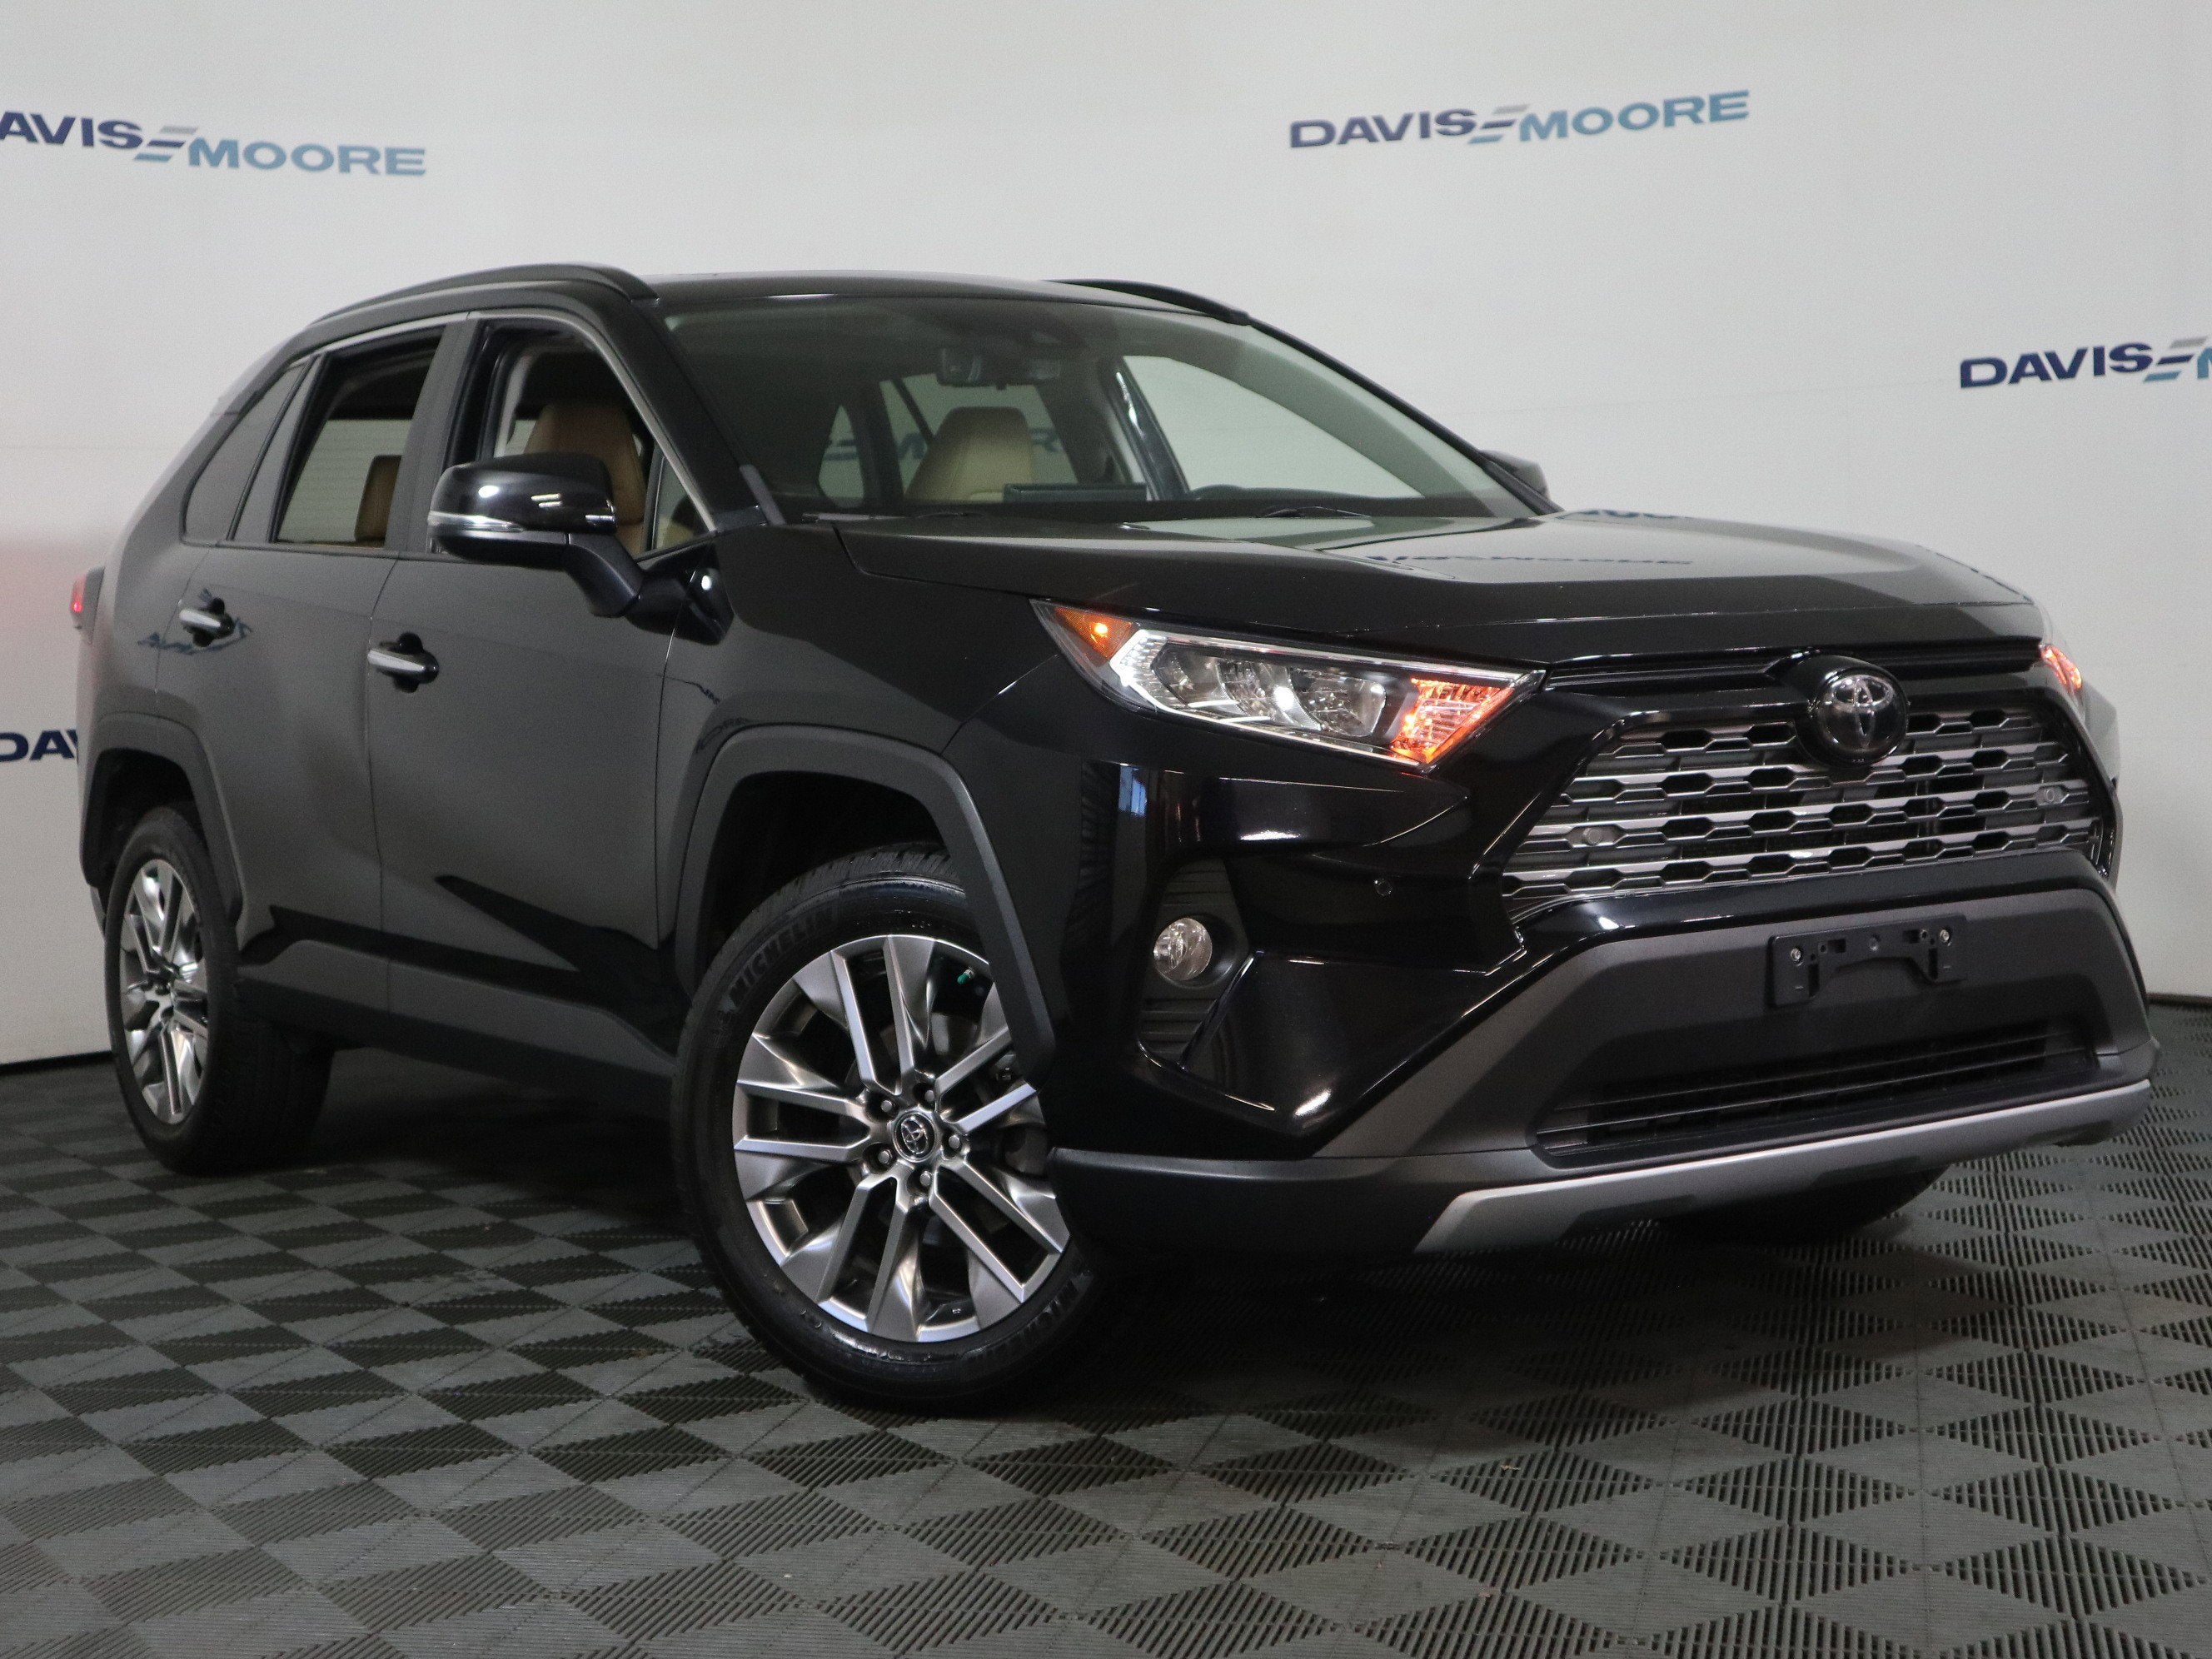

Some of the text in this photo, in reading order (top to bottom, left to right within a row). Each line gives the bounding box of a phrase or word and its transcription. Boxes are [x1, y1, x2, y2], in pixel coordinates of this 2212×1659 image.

[1289, 89, 1750, 147] DAVIS MOORE
[188, 137, 426, 177] MOORE
[1960, 342, 2154, 388] DAVIS
[0, 729, 78, 764] DA
[728, 906, 834, 1007] MICHELIN
